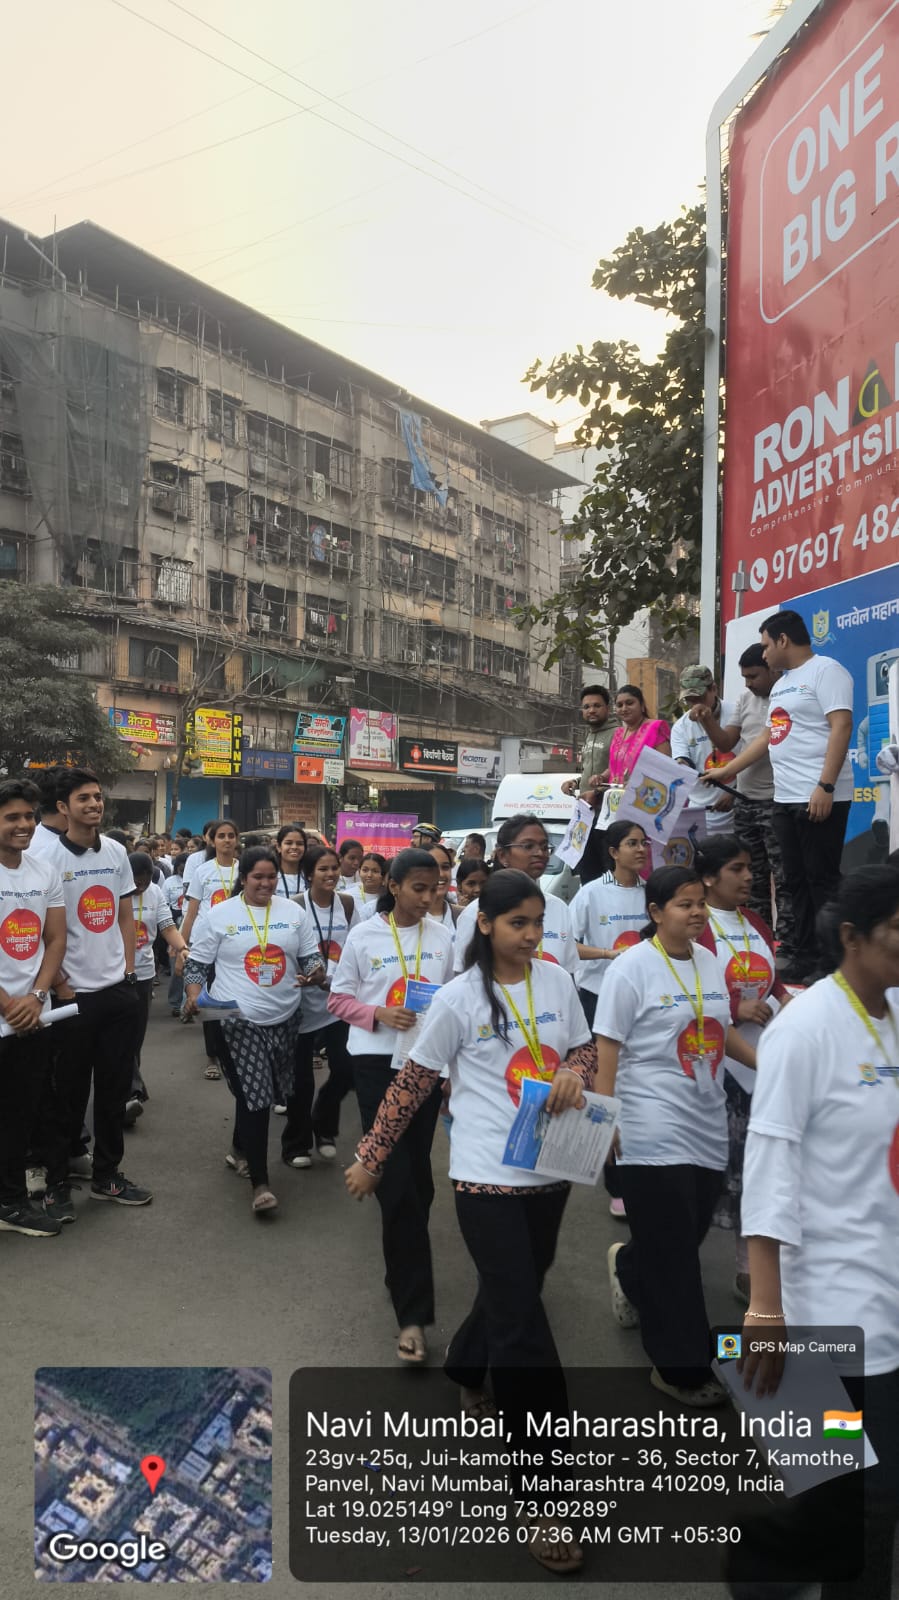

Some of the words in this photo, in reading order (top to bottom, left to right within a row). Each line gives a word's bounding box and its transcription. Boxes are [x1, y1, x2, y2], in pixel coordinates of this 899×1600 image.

[787, 43, 885, 196] ONE
[782, 168, 857, 287] BIG
[751, 411, 899, 524] ADVERTISI
[749, 494, 831, 538] Comprehensive
[772, 523, 845, 584] 97697
[836, 606, 870, 630] पनवेल
[233, 714, 242, 774] PRINT
